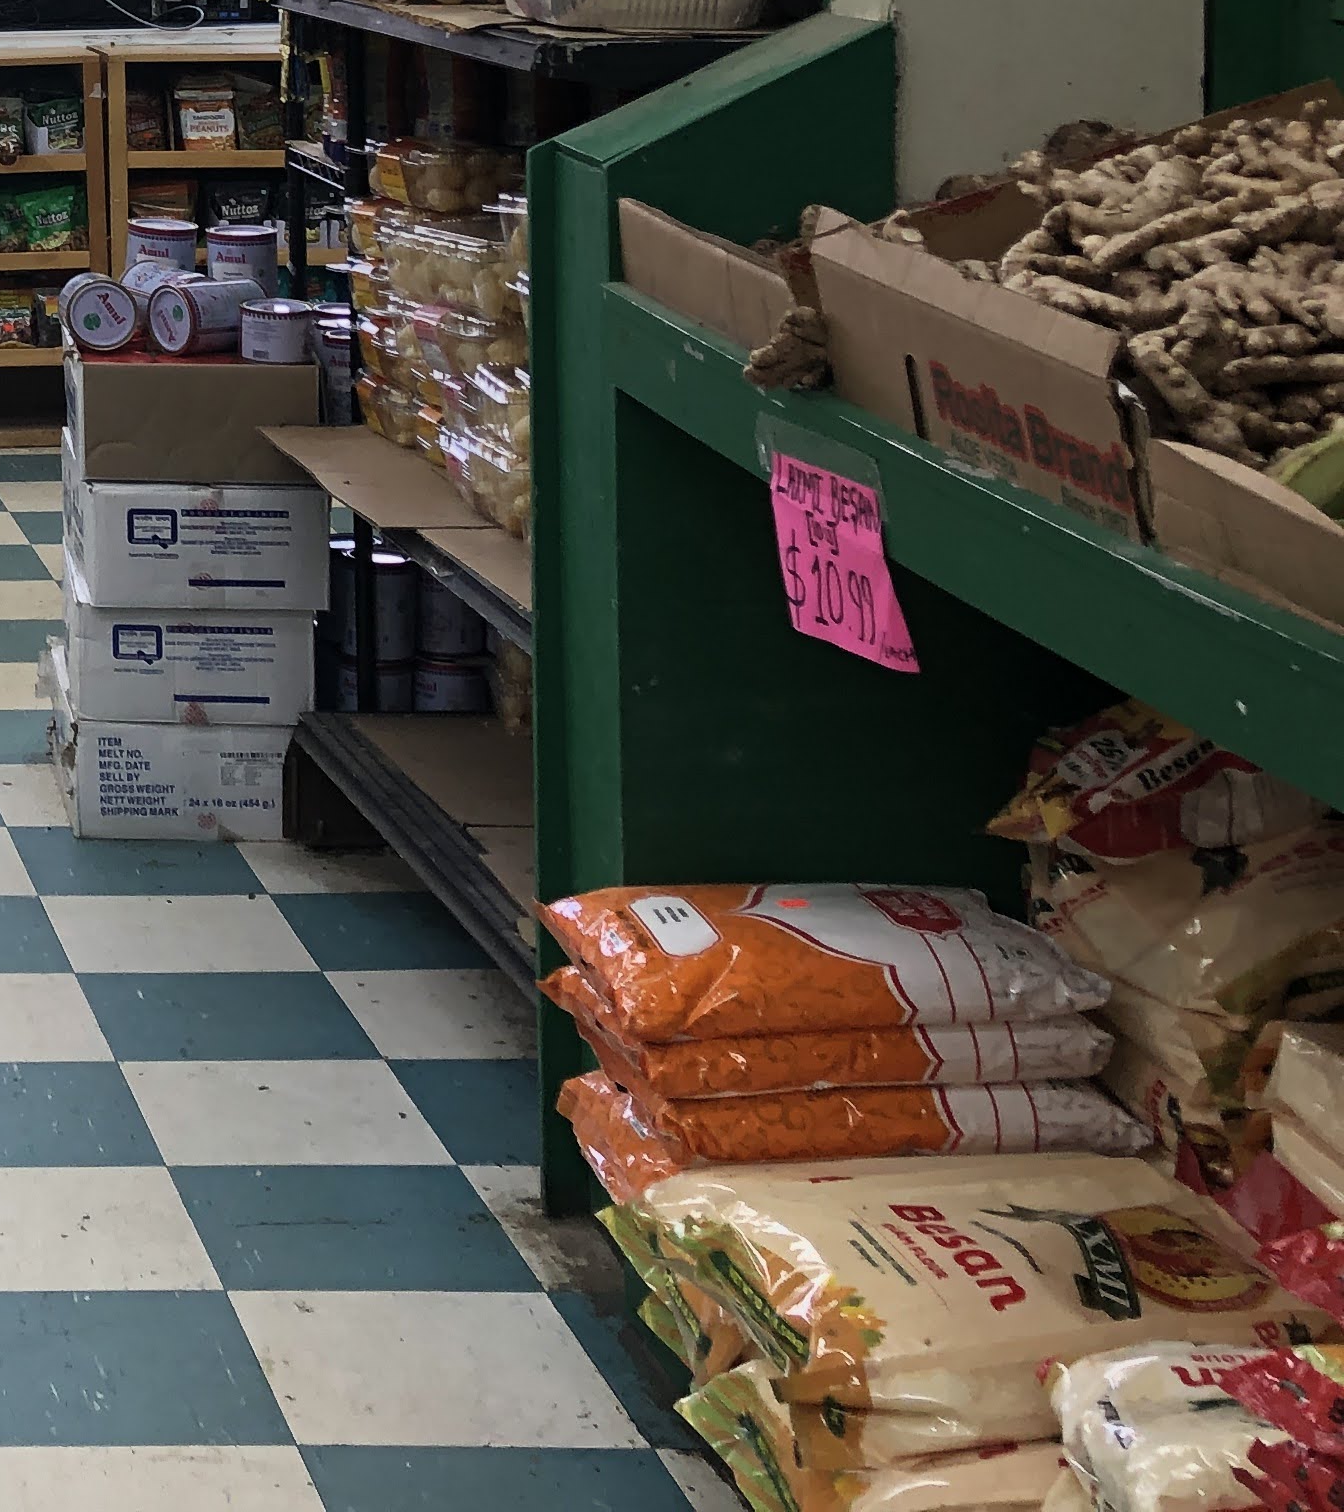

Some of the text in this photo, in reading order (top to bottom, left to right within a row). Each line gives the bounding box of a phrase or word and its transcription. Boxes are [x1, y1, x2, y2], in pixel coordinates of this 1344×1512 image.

[43, 111, 78, 125] Nuttoz
[189, 124, 230, 133] PEANUTS
[222, 205, 259, 218] Nuttoz
[35, 210, 69, 227] Nuttoz
[138, 244, 170, 258] Amul
[215, 251, 247, 264] Amul
[96, 292, 128, 326] Amul
[1023, 402, 1136, 516] Brand
[830, 475, 882, 536] BESAN
[785, 528, 877, 647] $10.99
[97, 737, 122, 747] ITEM
[98, 749, 144, 759] MELT NO.
[98, 761, 151, 771] MFG. DATE
[1137, 737, 1217, 790] Besan
[99, 773, 140, 782] SELL BY
[99, 784, 176, 795] GROSS WEIGHT
[100, 796, 126, 805] NETT
[126, 796, 166, 806] WEIGHT
[188, 798, 201, 808] 24
[225, 800, 238, 808] oz
[239, 798, 260, 809] (454
[100, 807, 179, 817] SHIPPING MARK
[887, 1203, 1029, 1313] Besan
